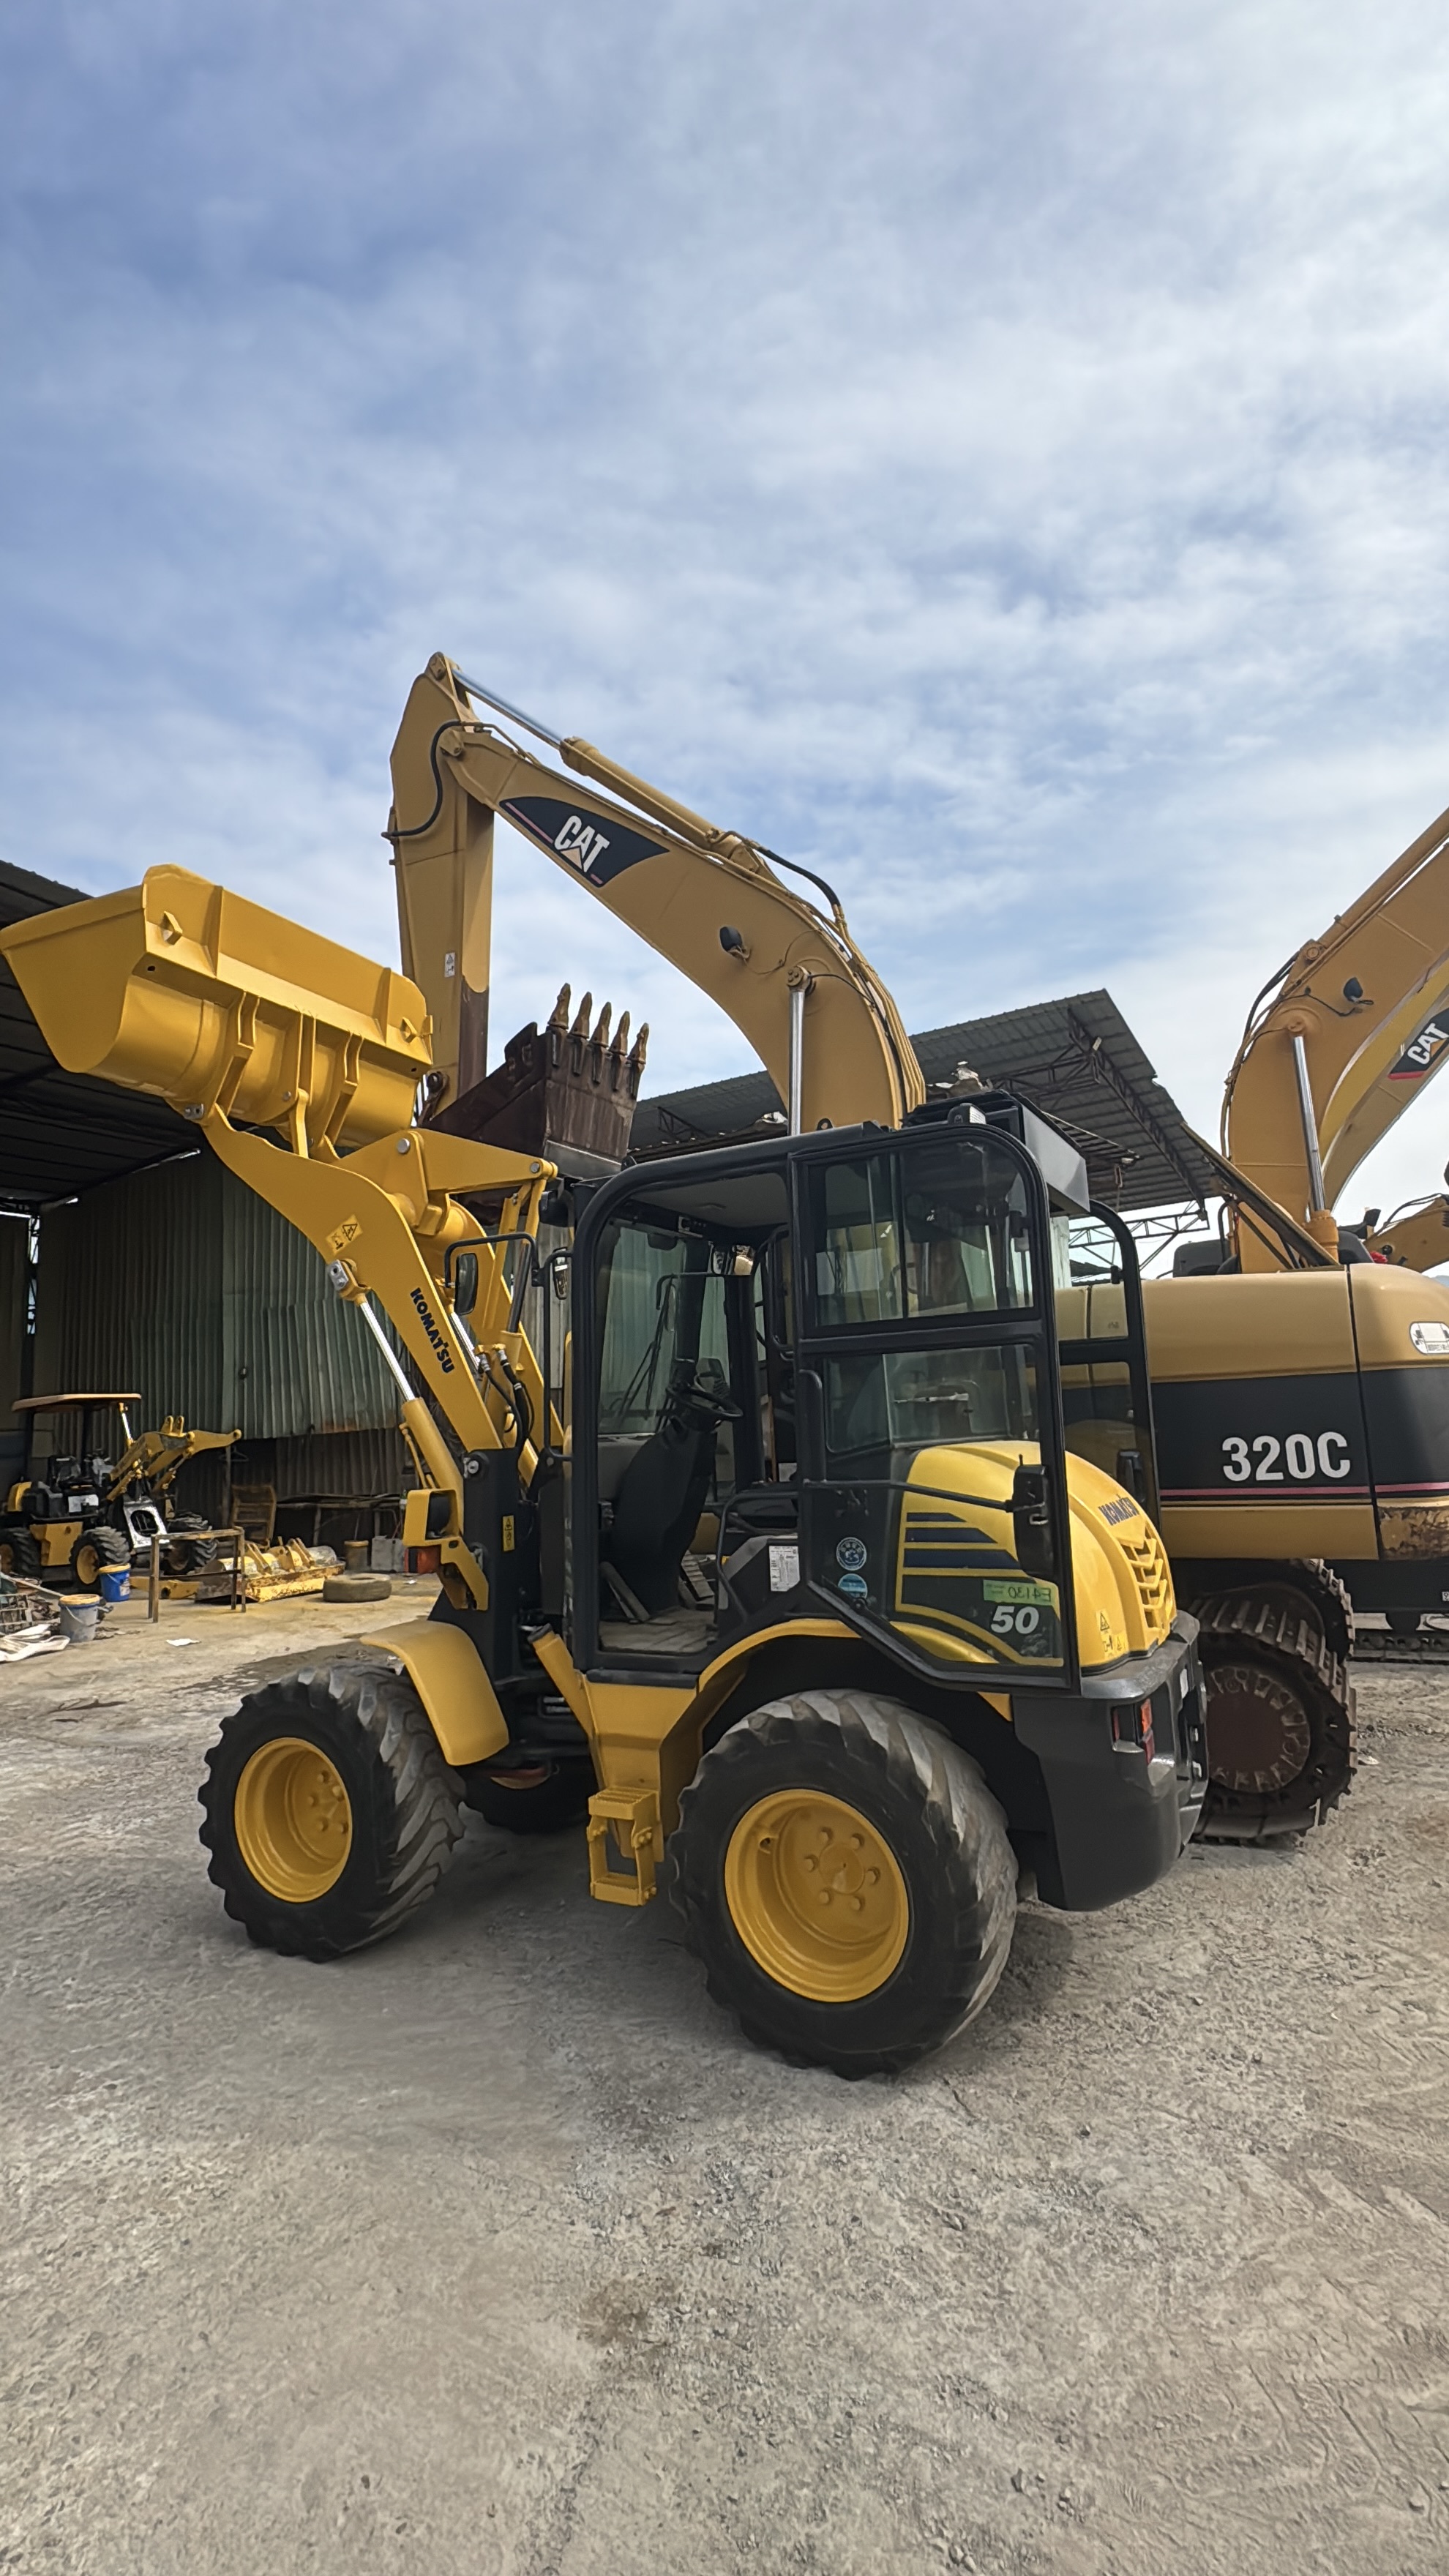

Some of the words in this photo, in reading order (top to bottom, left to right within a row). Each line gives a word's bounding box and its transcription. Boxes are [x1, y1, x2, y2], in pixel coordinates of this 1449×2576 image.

[554, 815, 610, 873] CAT
[1407, 1022, 1449, 1065] CAT
[410, 1287, 454, 1374] KOMATSU
[1222, 1431, 1351, 1482] 320C
[990, 1606, 1039, 1634] 50
